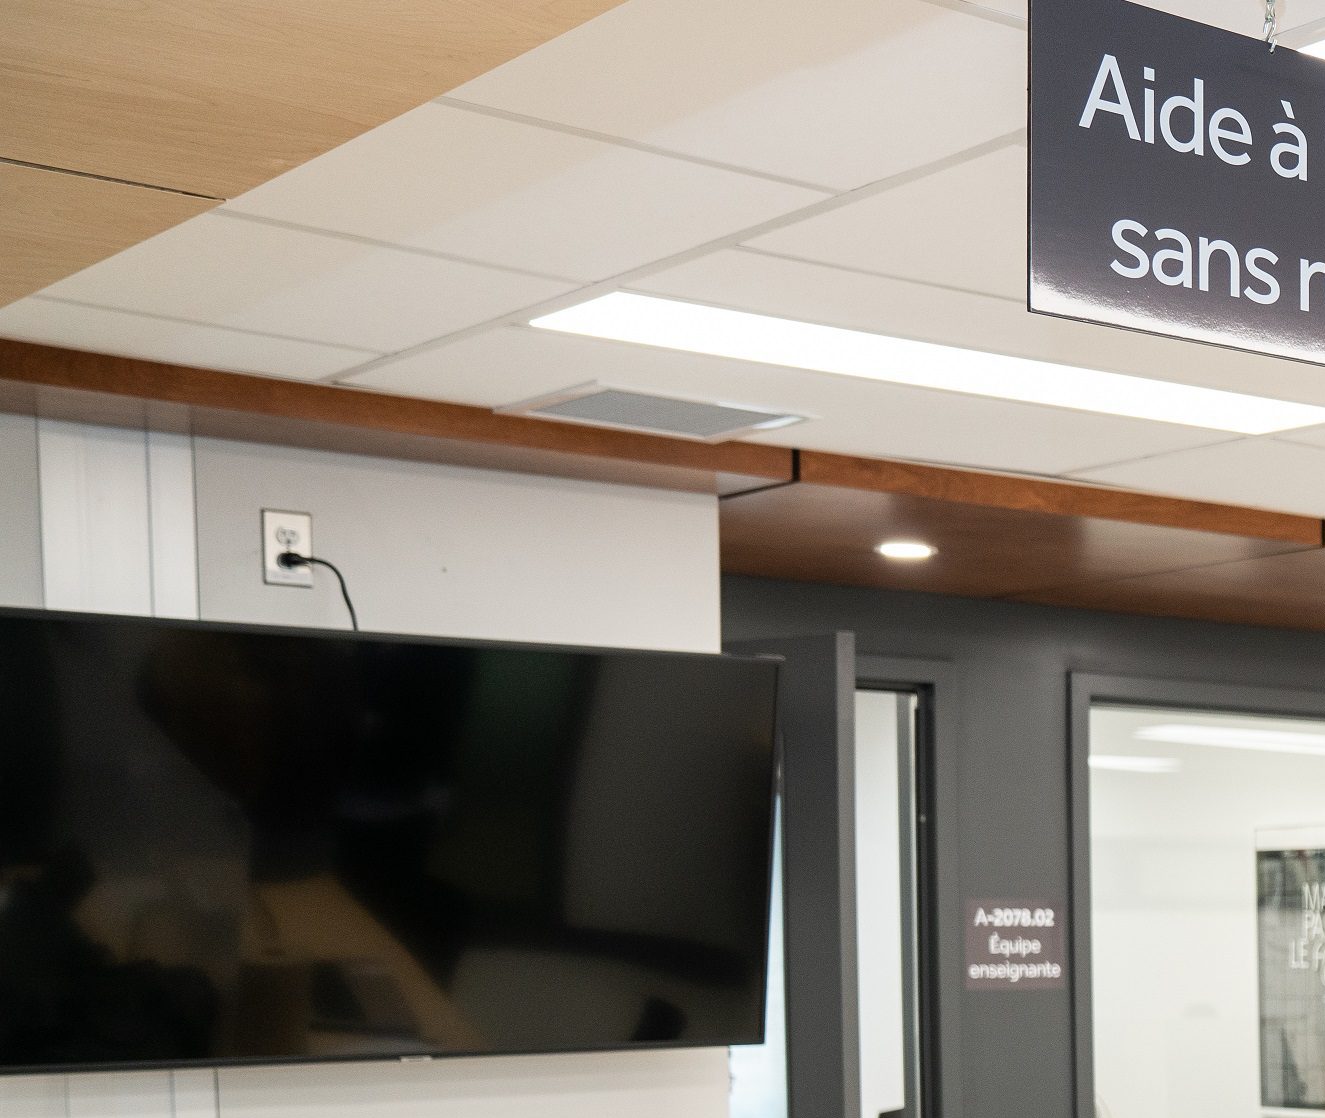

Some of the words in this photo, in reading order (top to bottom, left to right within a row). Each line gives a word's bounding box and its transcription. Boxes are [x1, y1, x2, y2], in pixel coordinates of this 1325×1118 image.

[1079, 54, 1253, 166] Aide
[1270, 100, 1308, 183] à
[1110, 219, 1280, 305] sans
[968, 960, 1061, 982] enseignante
[988, 931, 1041, 958] Équipe
